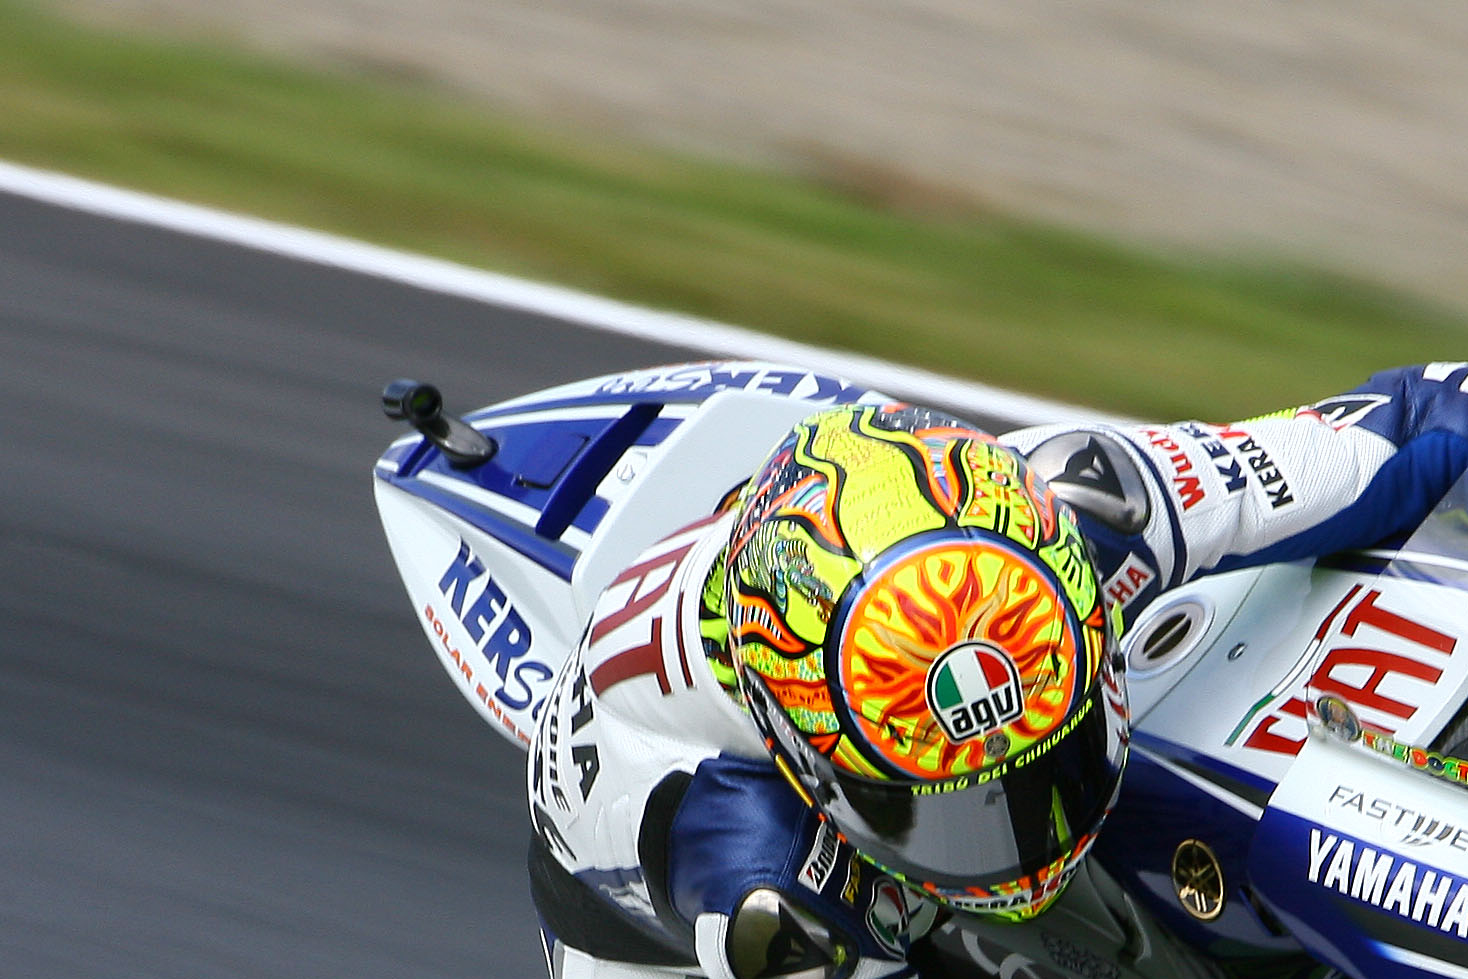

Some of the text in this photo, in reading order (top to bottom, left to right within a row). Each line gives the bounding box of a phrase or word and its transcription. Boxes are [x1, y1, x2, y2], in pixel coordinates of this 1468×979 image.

[1106, 565, 1151, 610] HA
[424, 604, 474, 685] SOLAR
[438, 536, 554, 721] KERS
[570, 664, 601, 803] HA
[951, 684, 1016, 734] agv
[1362, 730, 1410, 764] THE
[977, 763, 1008, 786] DEI
